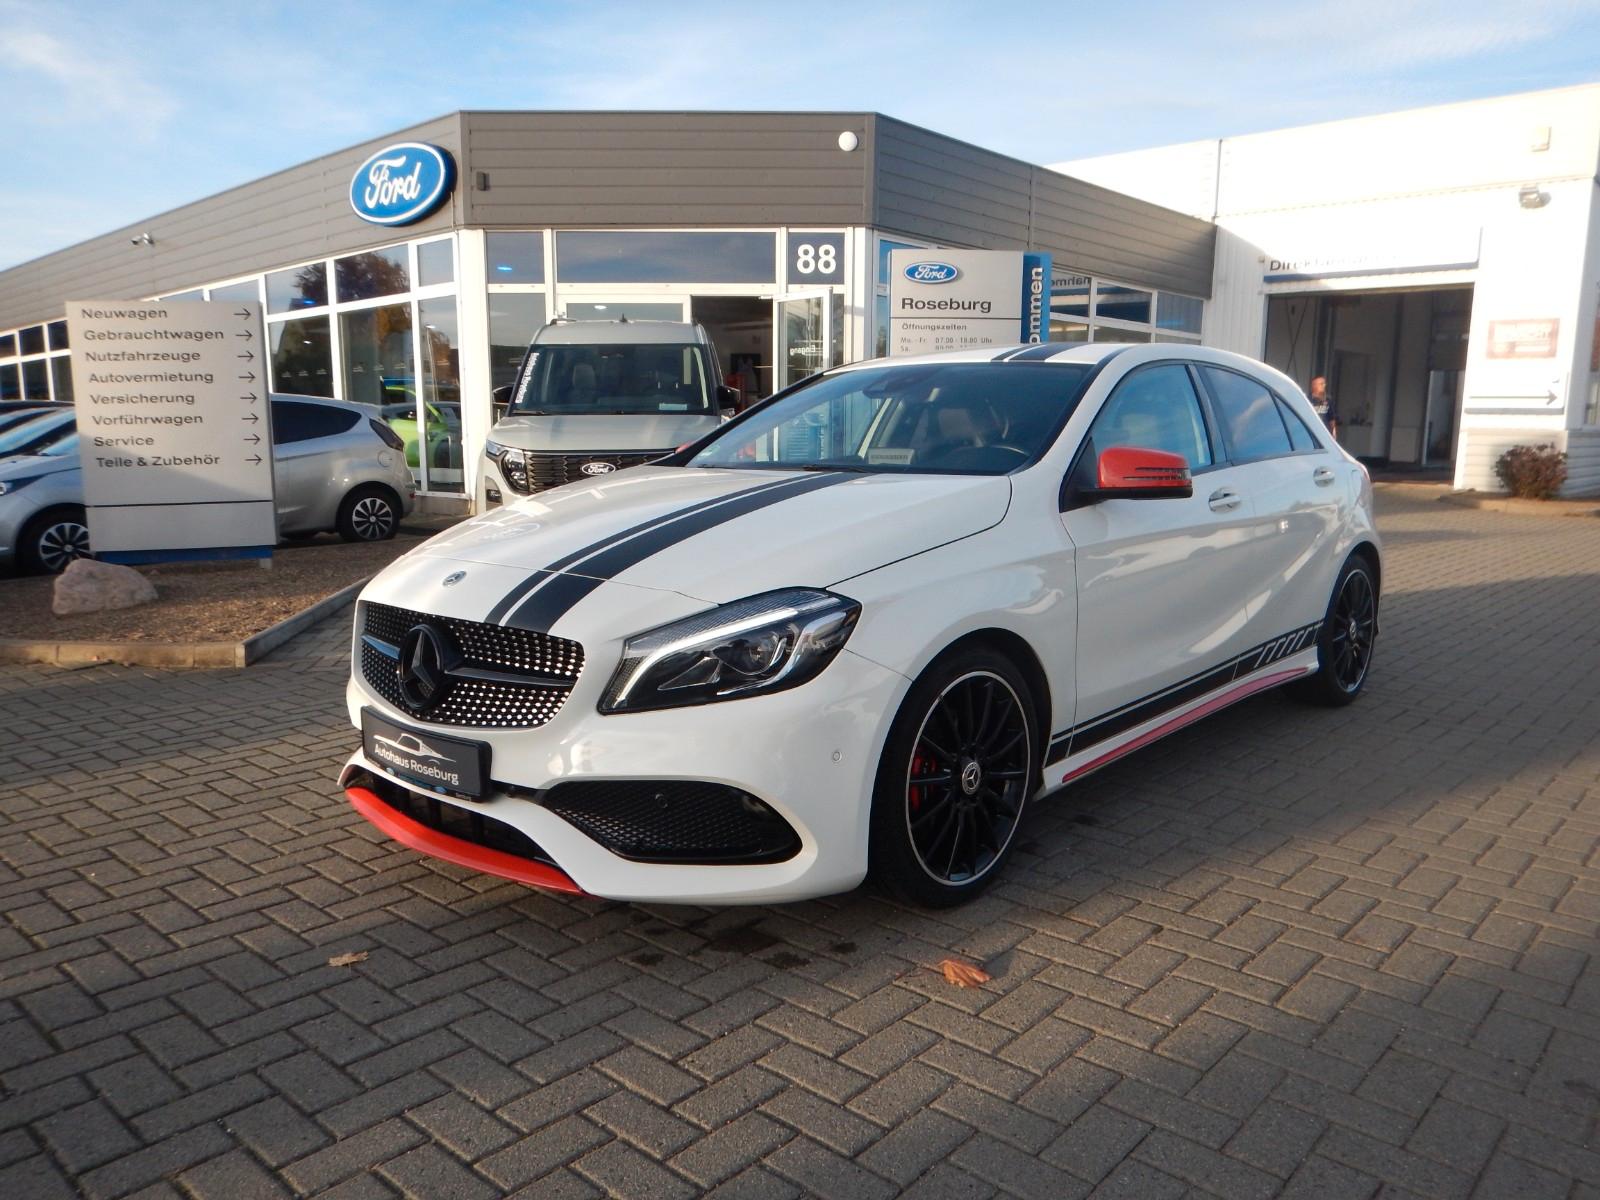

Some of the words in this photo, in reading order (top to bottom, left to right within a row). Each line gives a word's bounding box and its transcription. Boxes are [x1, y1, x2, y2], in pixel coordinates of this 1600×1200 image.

[364, 155, 422, 209] Ford
[796, 244, 837, 274] 88
[914, 263, 948, 280] Ford
[901, 297, 992, 313] Roseburg
[1029, 267, 1044, 344] ommen
[81, 308, 168, 320] Neuwagen
[901, 321, 967, 333] Öffnungszeiten
[84, 329, 224, 341] Gebrauchtwagen
[85, 351, 201, 363] Nutzfahrzeuge
[88, 372, 214, 384] Autovermietung
[90, 394, 195, 405] Versicherung
[91, 414, 203, 427] Vorführwagen
[93, 435, 154, 447] Service
[96, 457, 133, 468] Teile
[137, 457, 148, 467] &
[152, 454, 220, 467] Zubehör
[374, 743, 410, 769] Autohaus
[410, 759, 459, 786] Roseburg
